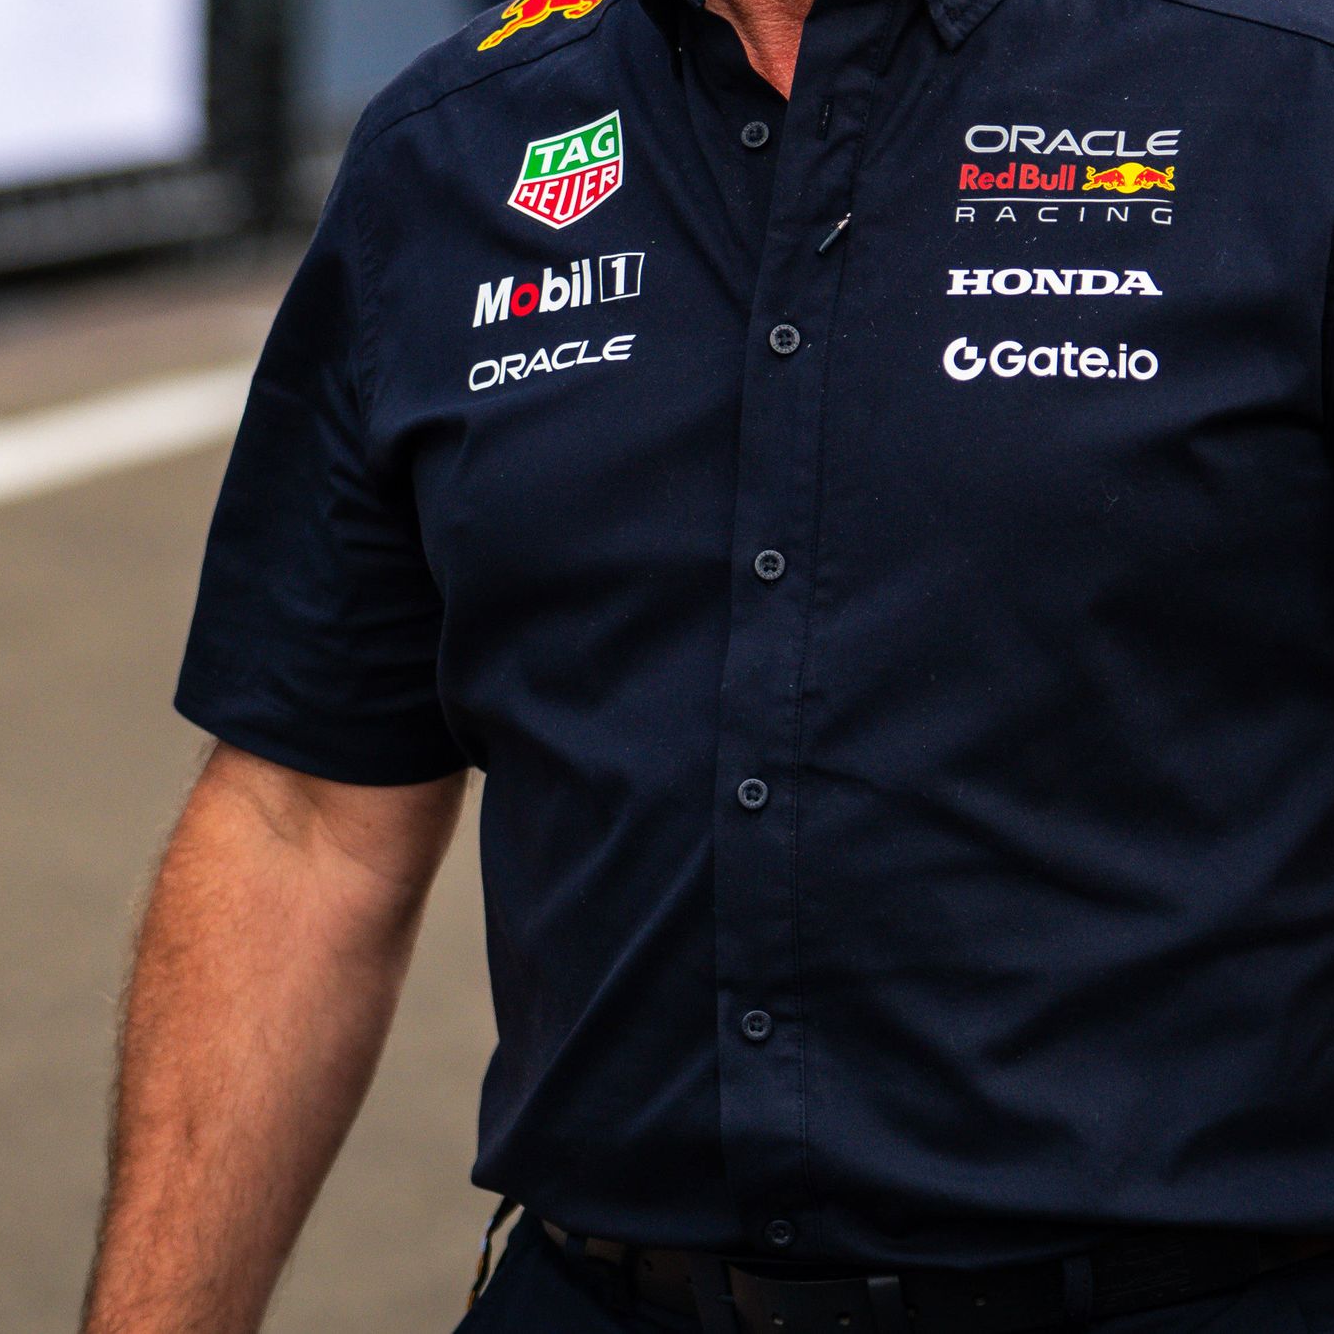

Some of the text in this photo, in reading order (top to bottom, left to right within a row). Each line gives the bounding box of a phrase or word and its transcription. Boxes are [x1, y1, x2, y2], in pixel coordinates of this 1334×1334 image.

[535, 124, 615, 174] TAG
[965, 125, 1182, 157] ORACLE
[519, 164, 617, 221] HEUER
[959, 163, 1077, 191] Red Bull
[955, 206, 1173, 225] RACING
[472, 258, 593, 328] Mobil
[946, 268, 1164, 296] HONDA
[468, 334, 637, 392] ORACLE
[989, 340, 1159, 381] Gate.io
